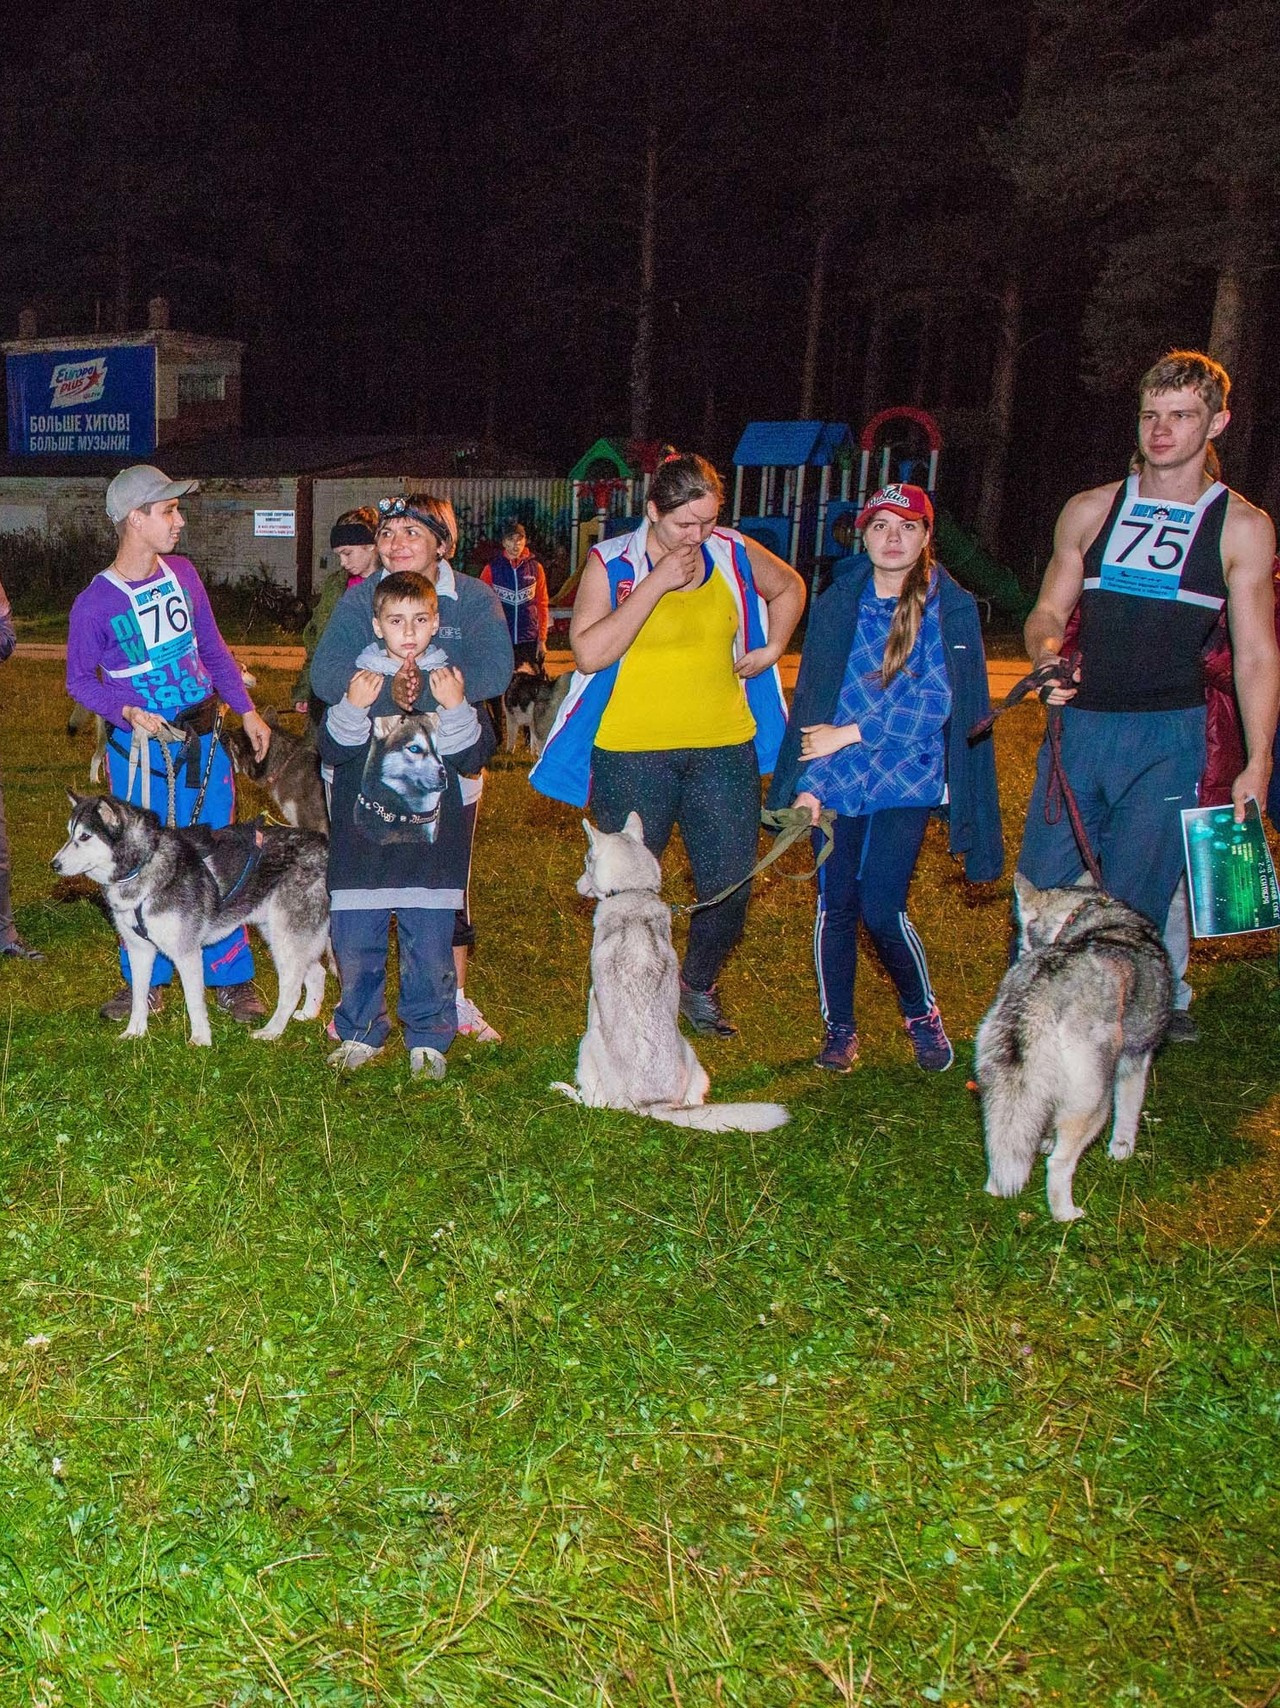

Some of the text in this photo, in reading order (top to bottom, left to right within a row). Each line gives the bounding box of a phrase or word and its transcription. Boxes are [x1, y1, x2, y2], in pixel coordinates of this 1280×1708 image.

[30, 413, 130, 433] БОЛЬШЕ ХИТОВ!
[30, 435, 130, 451] БОЛЬШЕ МУЗЫКИ!
[1115, 520, 1190, 570] 75
[138, 596, 188, 643] 76
[136, 677, 212, 710] 198
